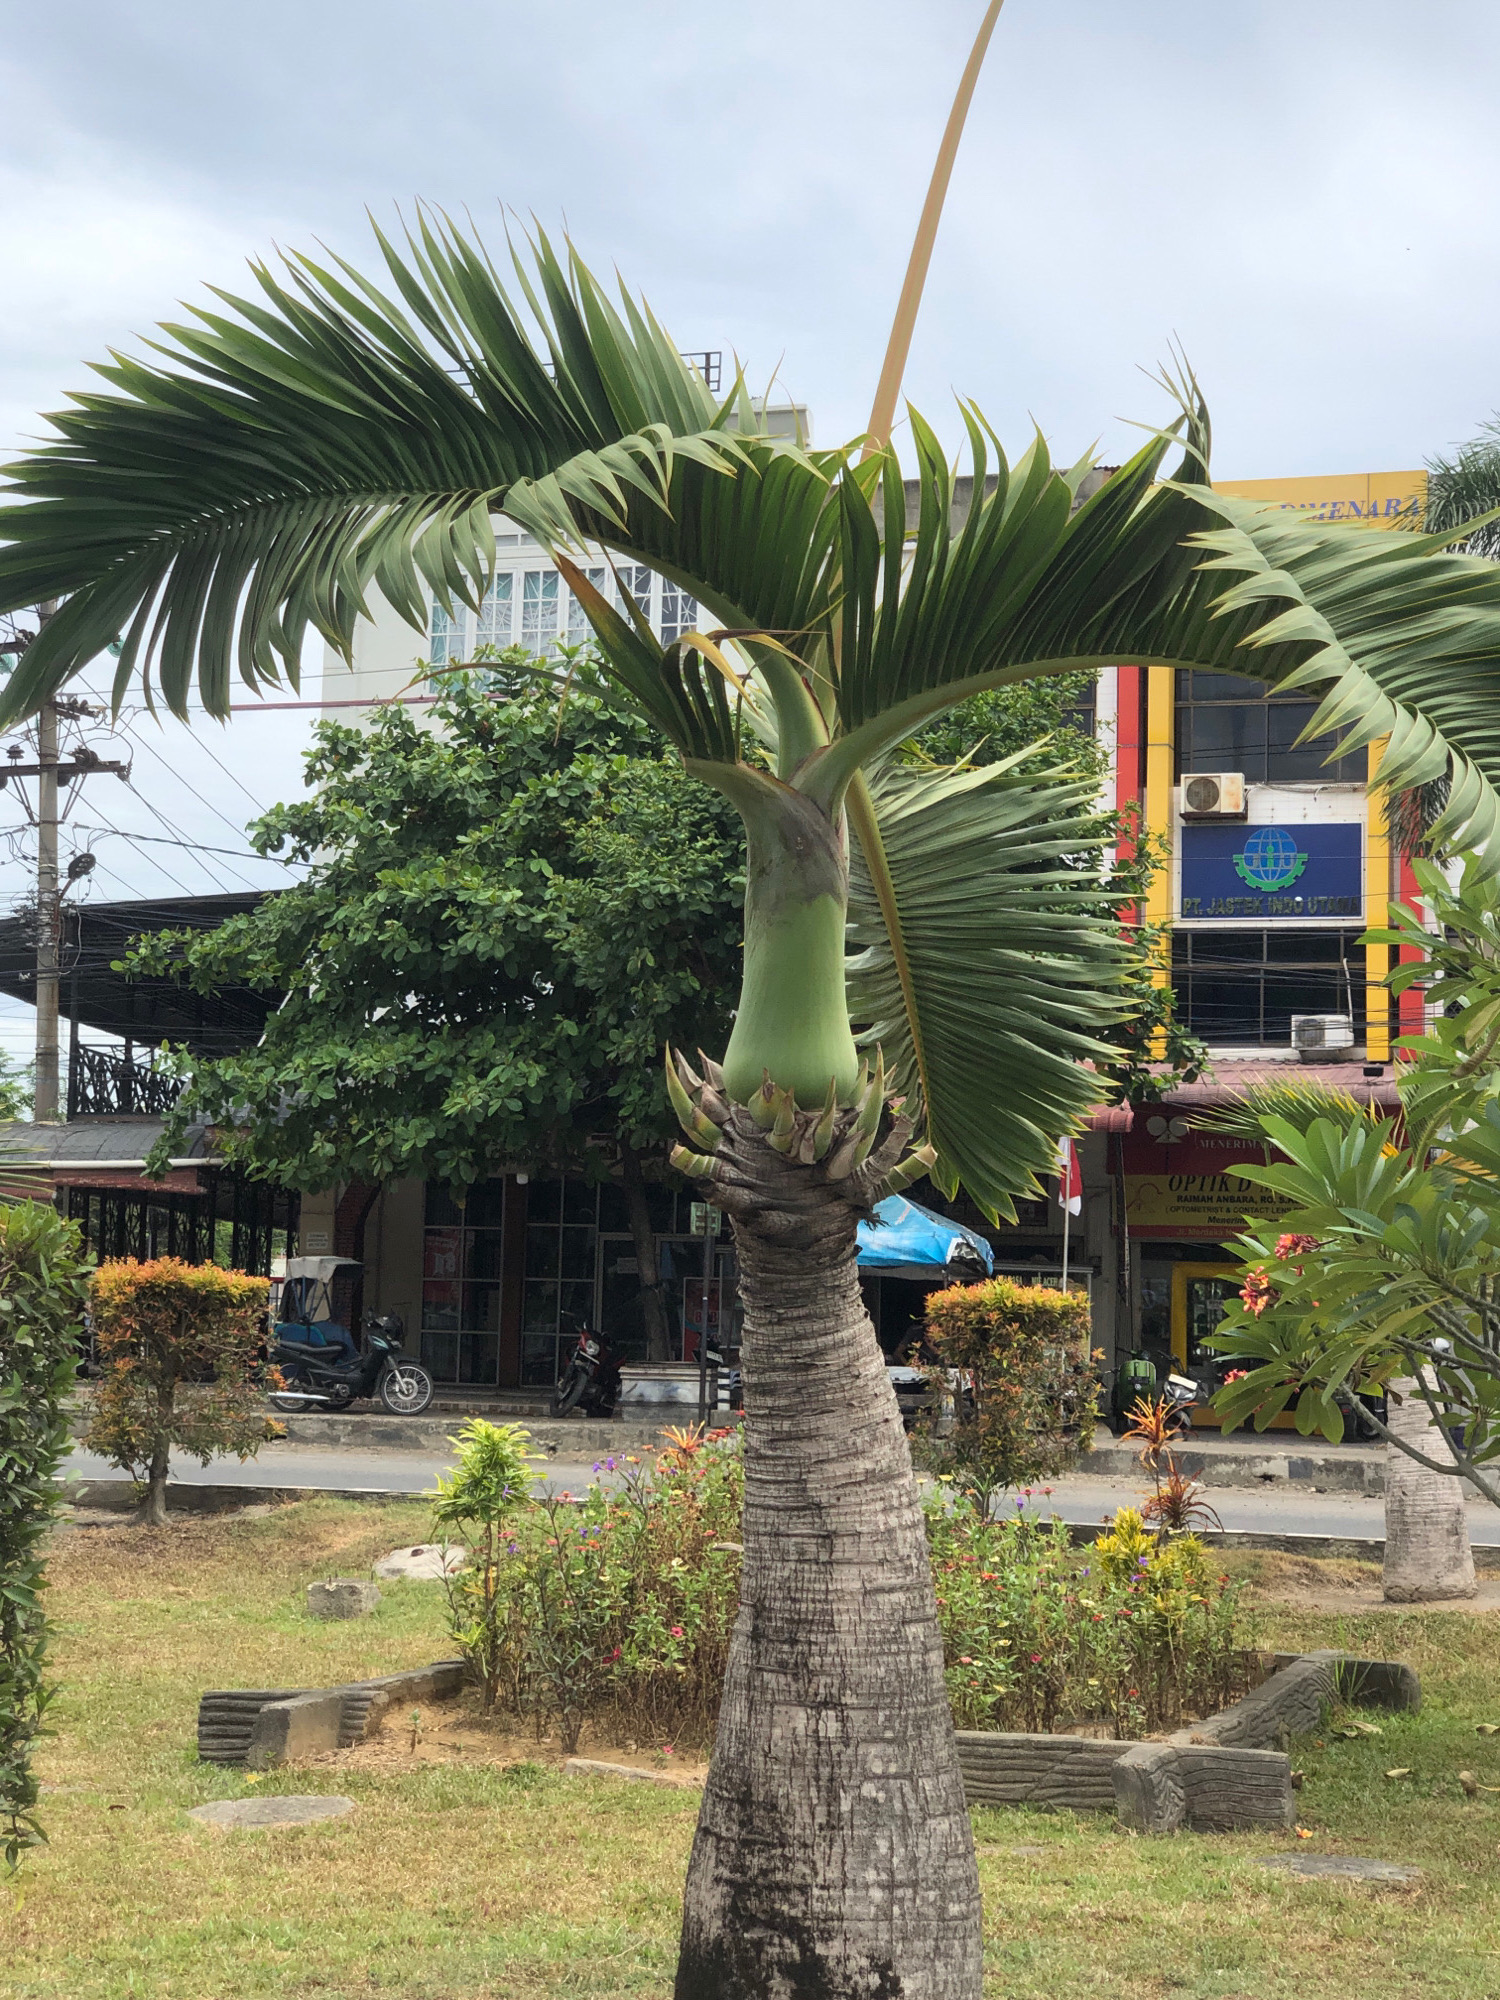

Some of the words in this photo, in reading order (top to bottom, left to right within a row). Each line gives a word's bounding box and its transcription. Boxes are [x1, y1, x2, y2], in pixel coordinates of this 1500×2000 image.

[1183, 898, 1203, 916] PT.
[1206, 897, 1265, 915] JASTEK
[1267, 896, 1304, 915] INDO
[1168, 1175, 1231, 1193] OPTIK
[1176, 1195, 1213, 1203] RAIMAH
[1225, 1206, 1232, 1214] &
[1233, 1205, 1269, 1214] CONTACT
